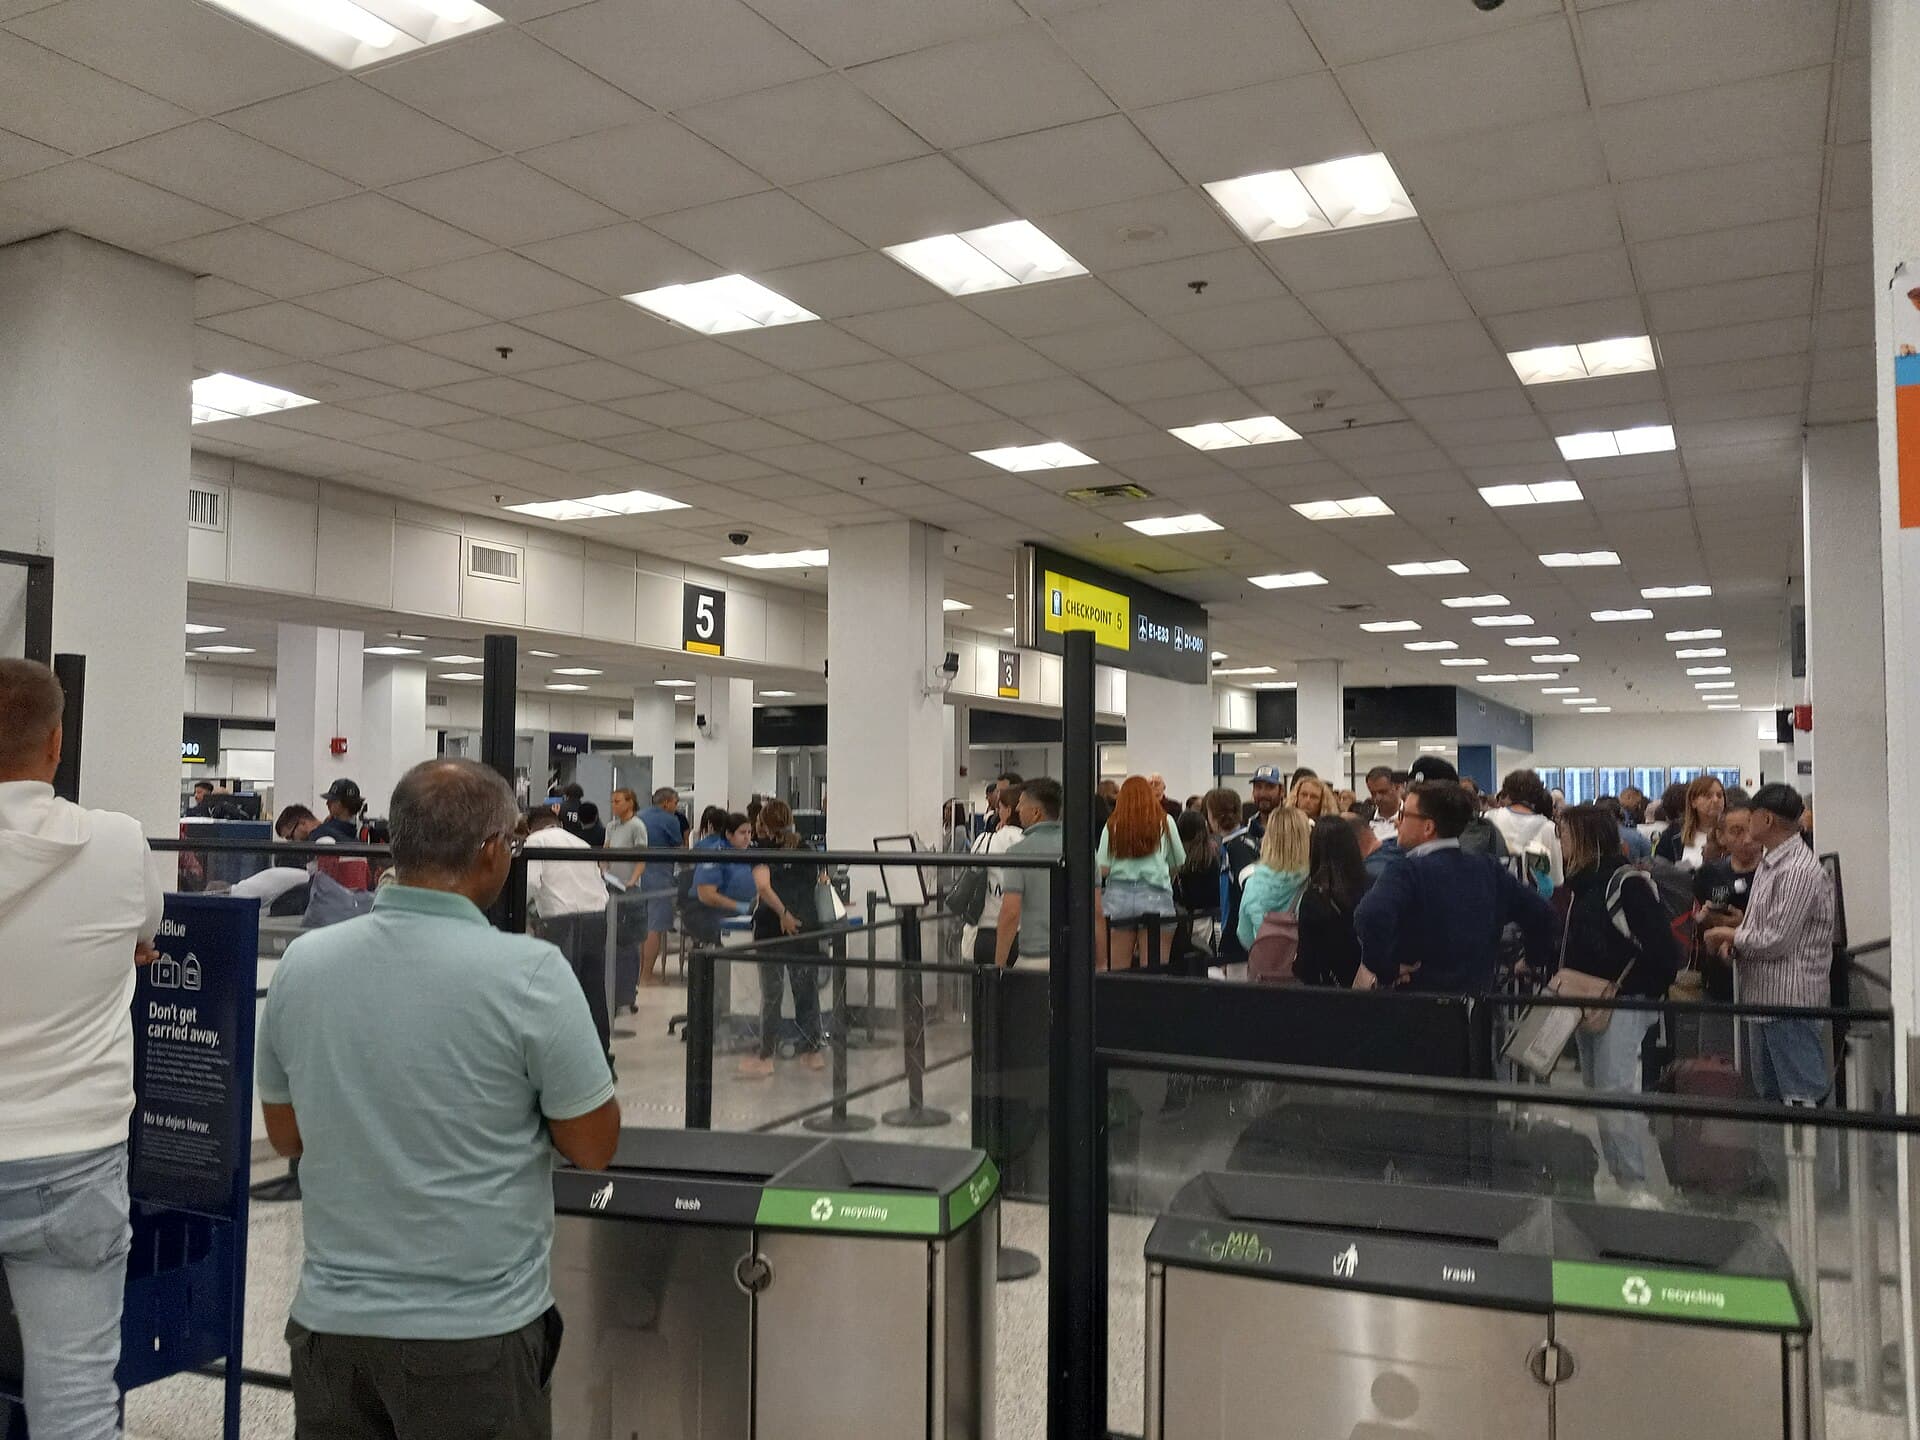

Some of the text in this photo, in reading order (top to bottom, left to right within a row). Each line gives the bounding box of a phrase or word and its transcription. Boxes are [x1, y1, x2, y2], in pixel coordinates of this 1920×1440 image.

[696, 594, 715, 639] 5
[1065, 599, 1124, 631] CHECKPOINT 5
[1005, 664, 1013, 687] 3
[148, 1001, 198, 1026] Don't get
[147, 1022, 188, 1041] carried
[189, 1028, 220, 1049] away.
[674, 1196, 702, 1211] trash
[840, 1205, 889, 1222] recycling
[1226, 1231, 1260, 1248] MIA
[1442, 1264, 1476, 1284] trash
[1661, 1286, 1726, 1310] recycling
